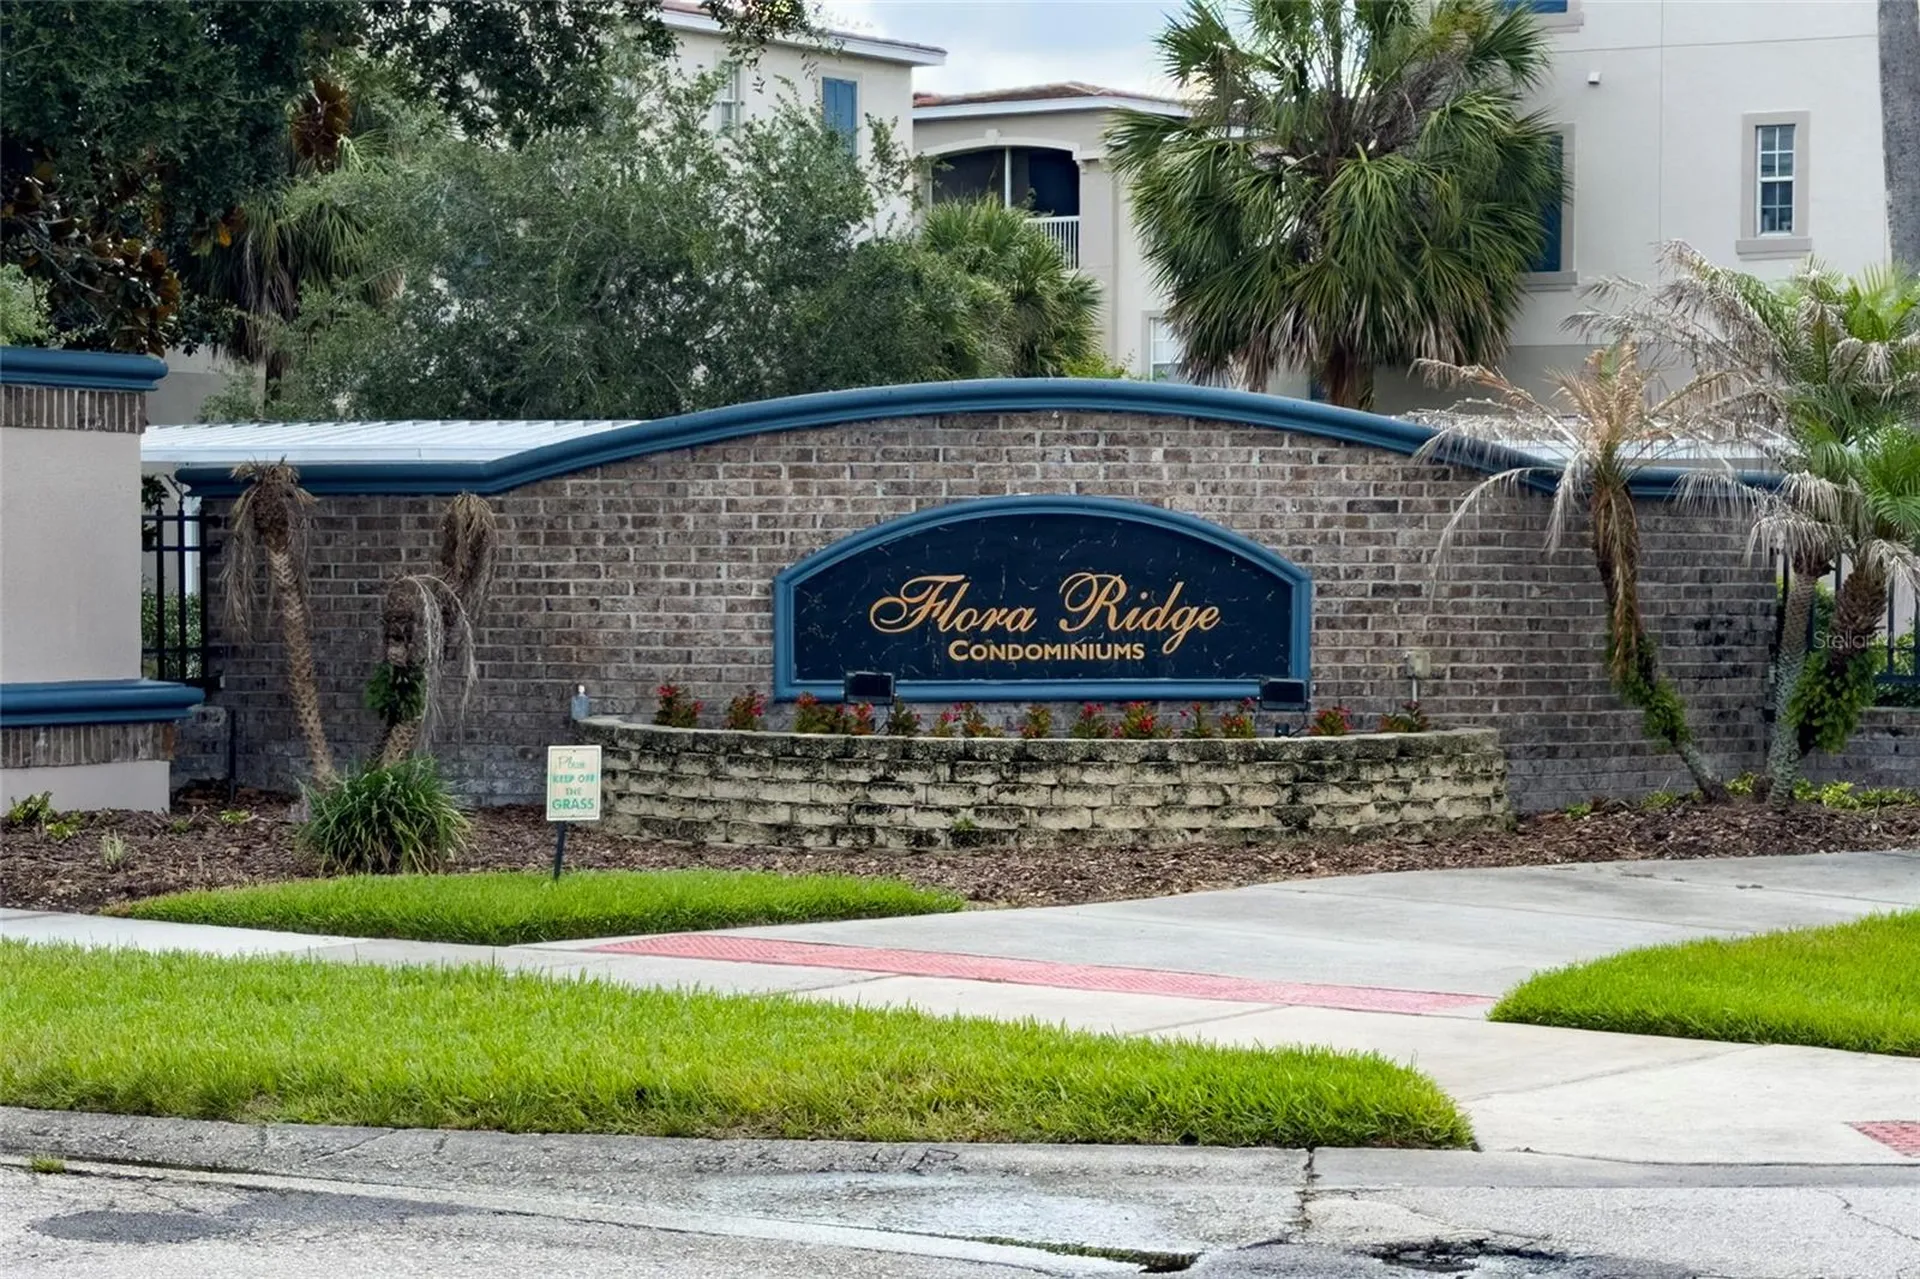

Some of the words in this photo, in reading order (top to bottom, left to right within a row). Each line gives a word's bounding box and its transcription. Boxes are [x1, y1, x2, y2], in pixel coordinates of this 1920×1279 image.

[869, 573, 1037, 634] Flora
[1057, 571, 1222, 656] Ridge
[552, 799, 595, 810] GRASS
